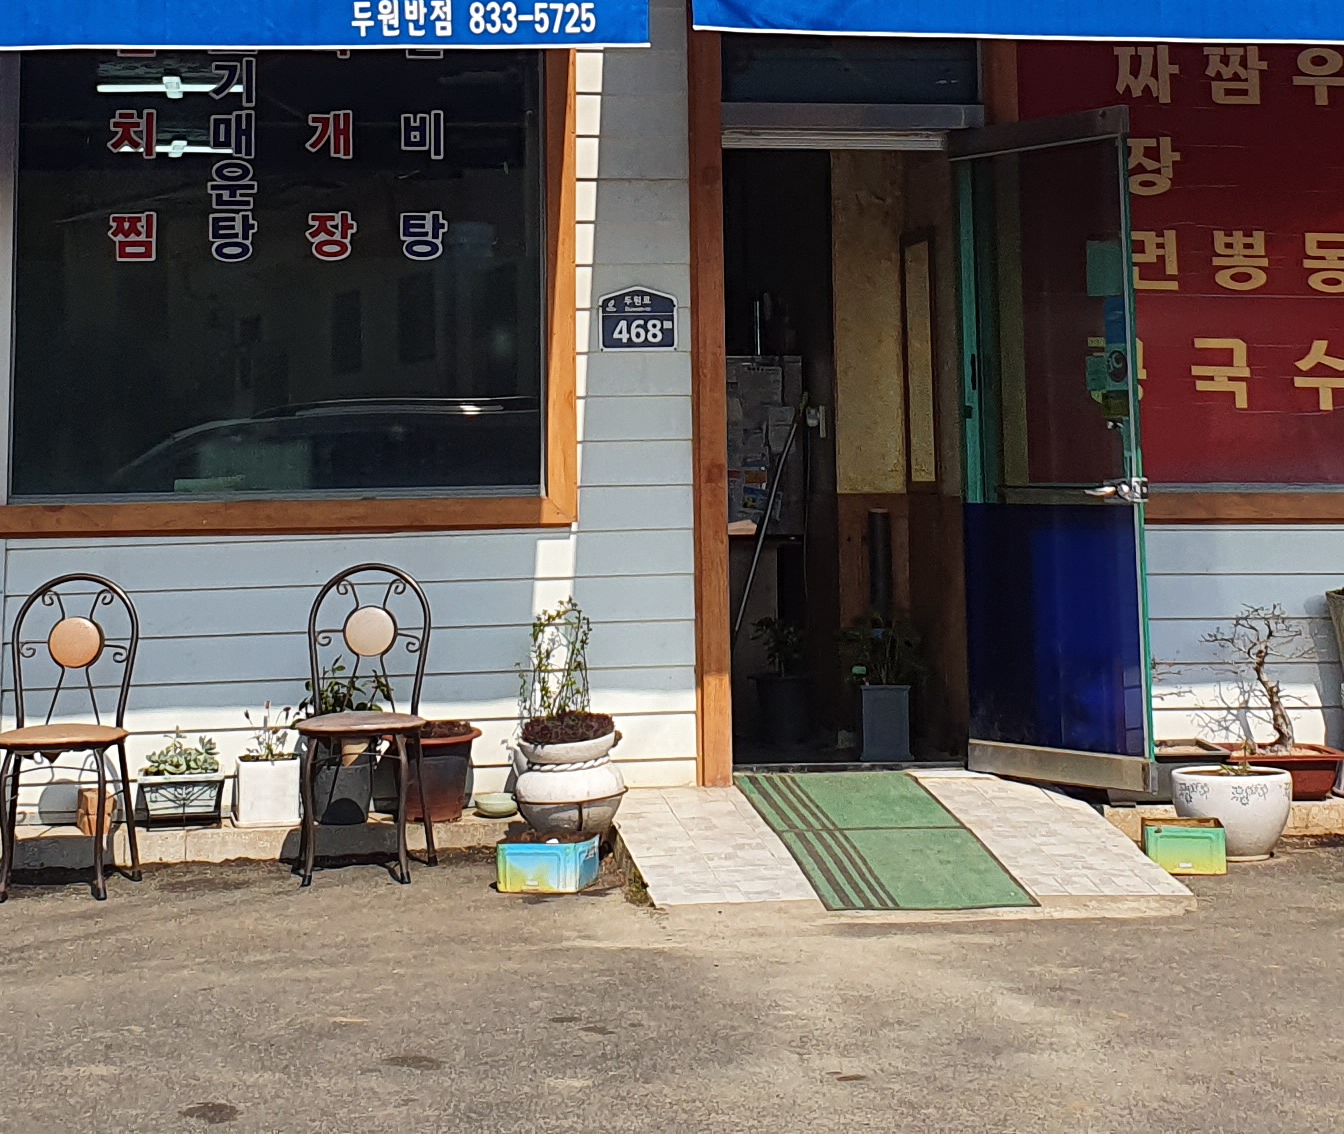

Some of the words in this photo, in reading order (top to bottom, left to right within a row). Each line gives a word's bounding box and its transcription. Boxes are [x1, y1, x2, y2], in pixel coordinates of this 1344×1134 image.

[351, 0, 453, 37] 두원반점
[468, 1, 597, 34] 833-5725
[107, 50, 156, 261] 치찜
[207, 50, 258, 261] 기매운탕
[305, 50, 357, 261] 개장
[400, 50, 449, 261] 비탕
[613, 319, 663, 343] 468
